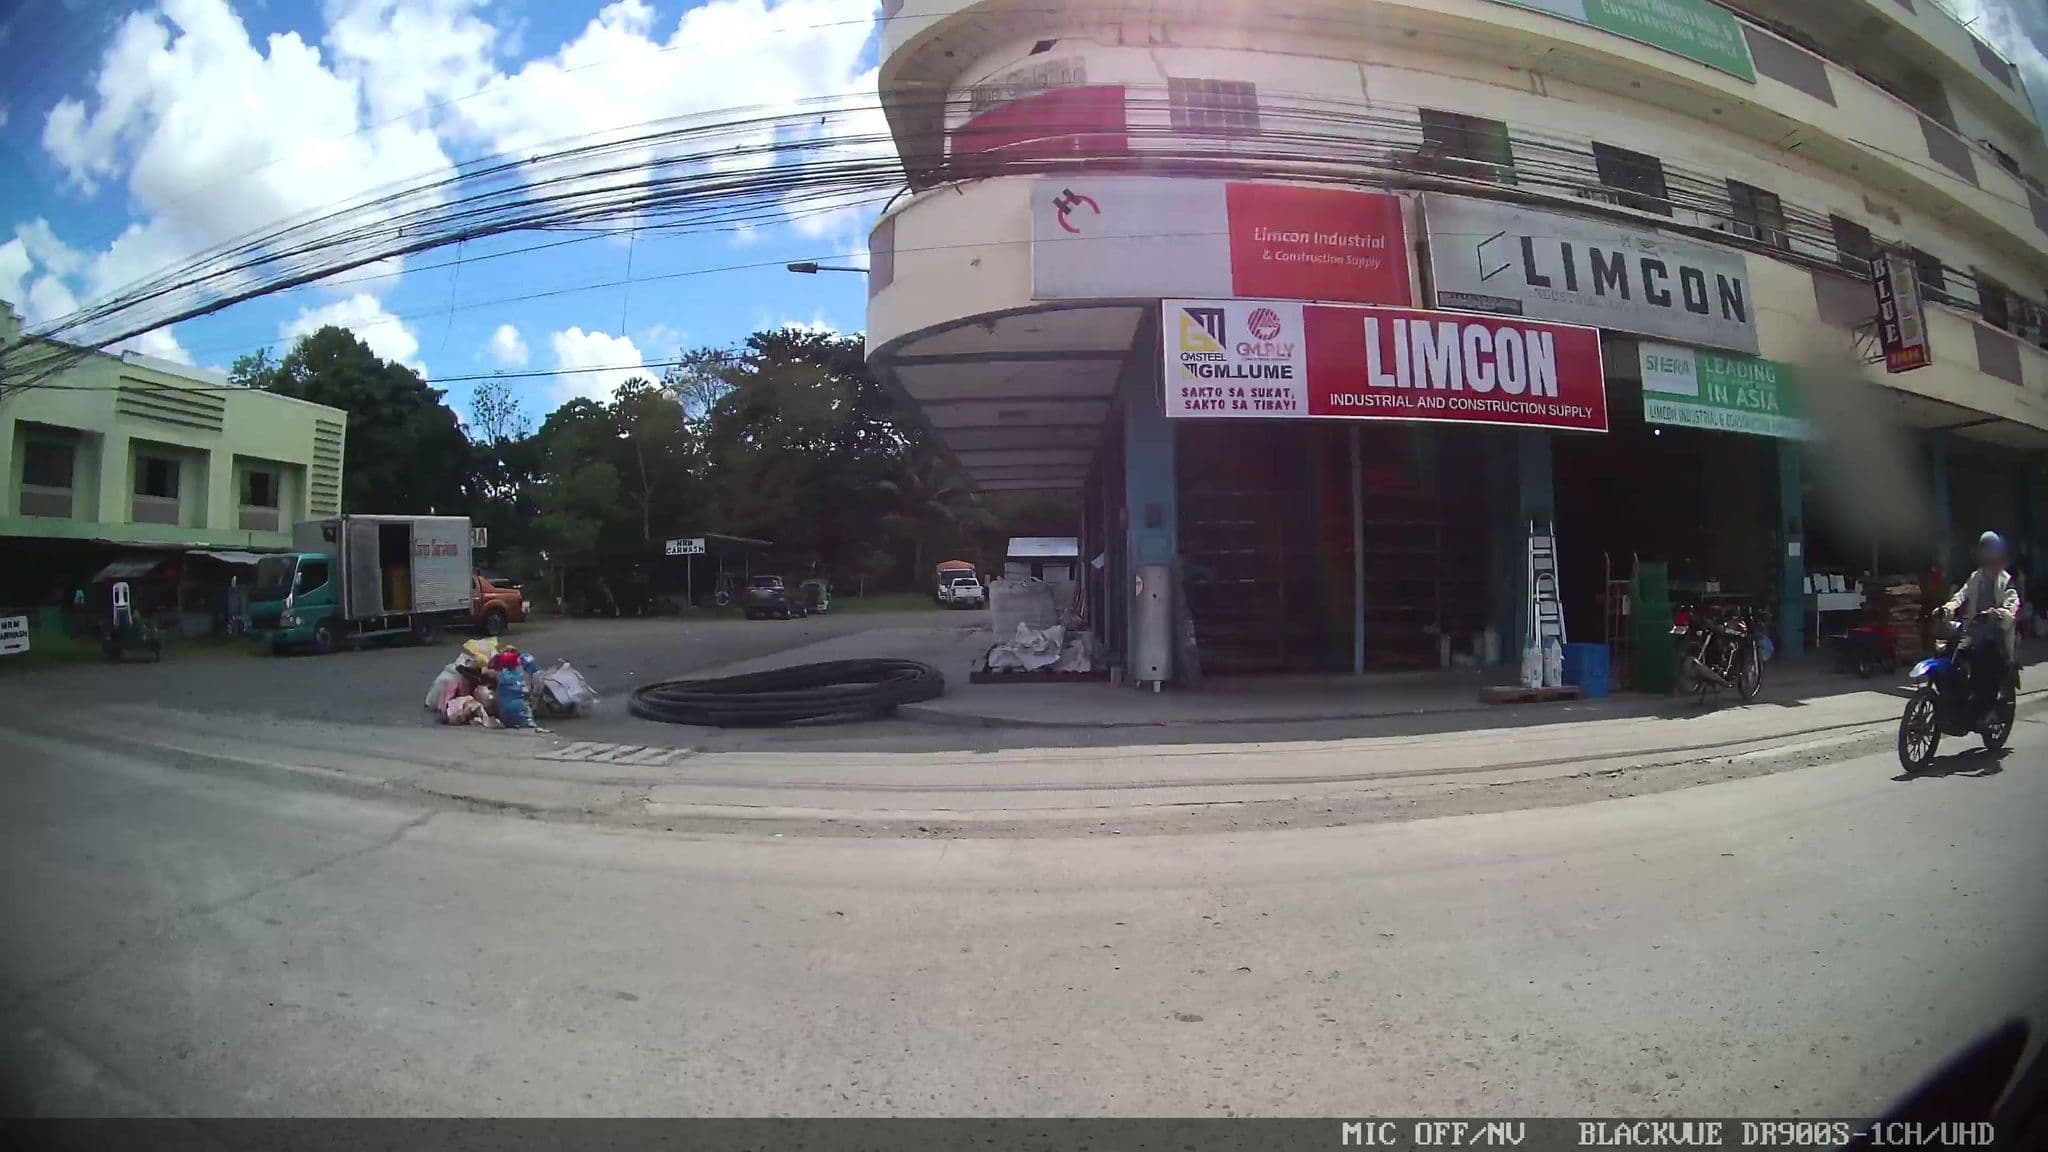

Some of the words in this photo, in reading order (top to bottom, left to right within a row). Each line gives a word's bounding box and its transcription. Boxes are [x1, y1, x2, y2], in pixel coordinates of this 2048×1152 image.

[1254, 226, 1309, 243] Limcon
[1314, 231, 1385, 249] Industrial
[1262, 248, 1272, 260] &
[1275, 250, 1344, 264] Construction
[1346, 254, 1381, 270] Supply
[1520, 235, 1746, 323] LIMCON
[1364, 316, 1559, 397] LIMCON
[1704, 356, 1776, 384] LEADING
[1181, 387, 1222, 398] SAKTO
[1228, 387, 1245, 398] SA
[1707, 382, 1729, 405] IN
[1736, 387, 1780, 411] ASIA
[1184, 399, 1225, 410] SAKTO
[1231, 400, 1248, 411] SA
[1330, 393, 1414, 408] INDUSTRIAL
[1417, 397, 1446, 409] AND
[1449, 398, 1546, 415] CONSTRUCTION
[1548, 404, 1592, 419] SUPPLY
[666, 546, 704, 554] CARWASH
